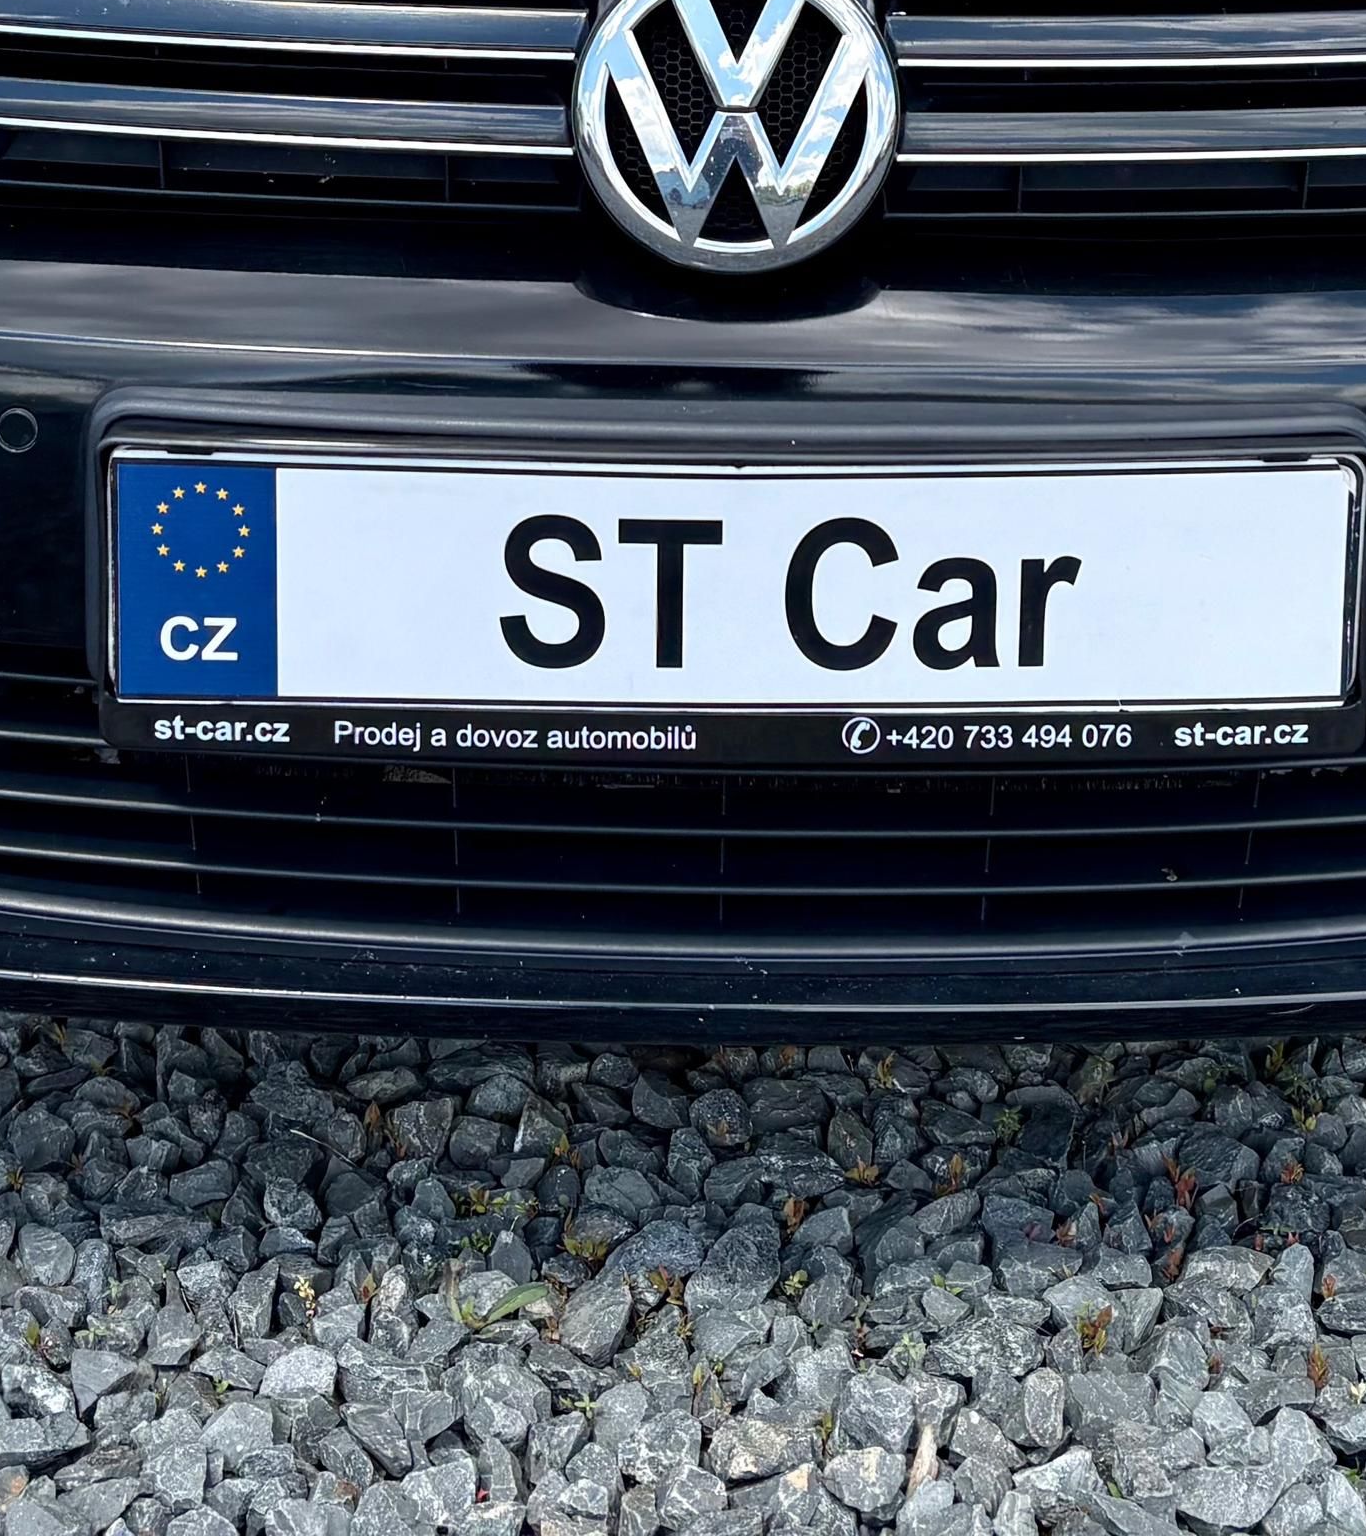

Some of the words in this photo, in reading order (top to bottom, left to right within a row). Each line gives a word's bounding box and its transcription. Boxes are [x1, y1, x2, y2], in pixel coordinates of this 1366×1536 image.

[499, 514, 724, 669] ST
[784, 517, 1082, 672] Car
[160, 615, 239, 661] CZ
[153, 714, 291, 744] st-car.cz
[333, 720, 422, 752] Prodej
[429, 727, 447, 747] a
[456, 723, 539, 749] dovoz
[545, 721, 698, 752] automobilů
[885, 724, 954, 750] +420
[963, 724, 1014, 749] 733
[1021, 723, 1073, 749] 494
[1081, 723, 1133, 748] 076
[1173, 721, 1310, 748] st-car.cz
